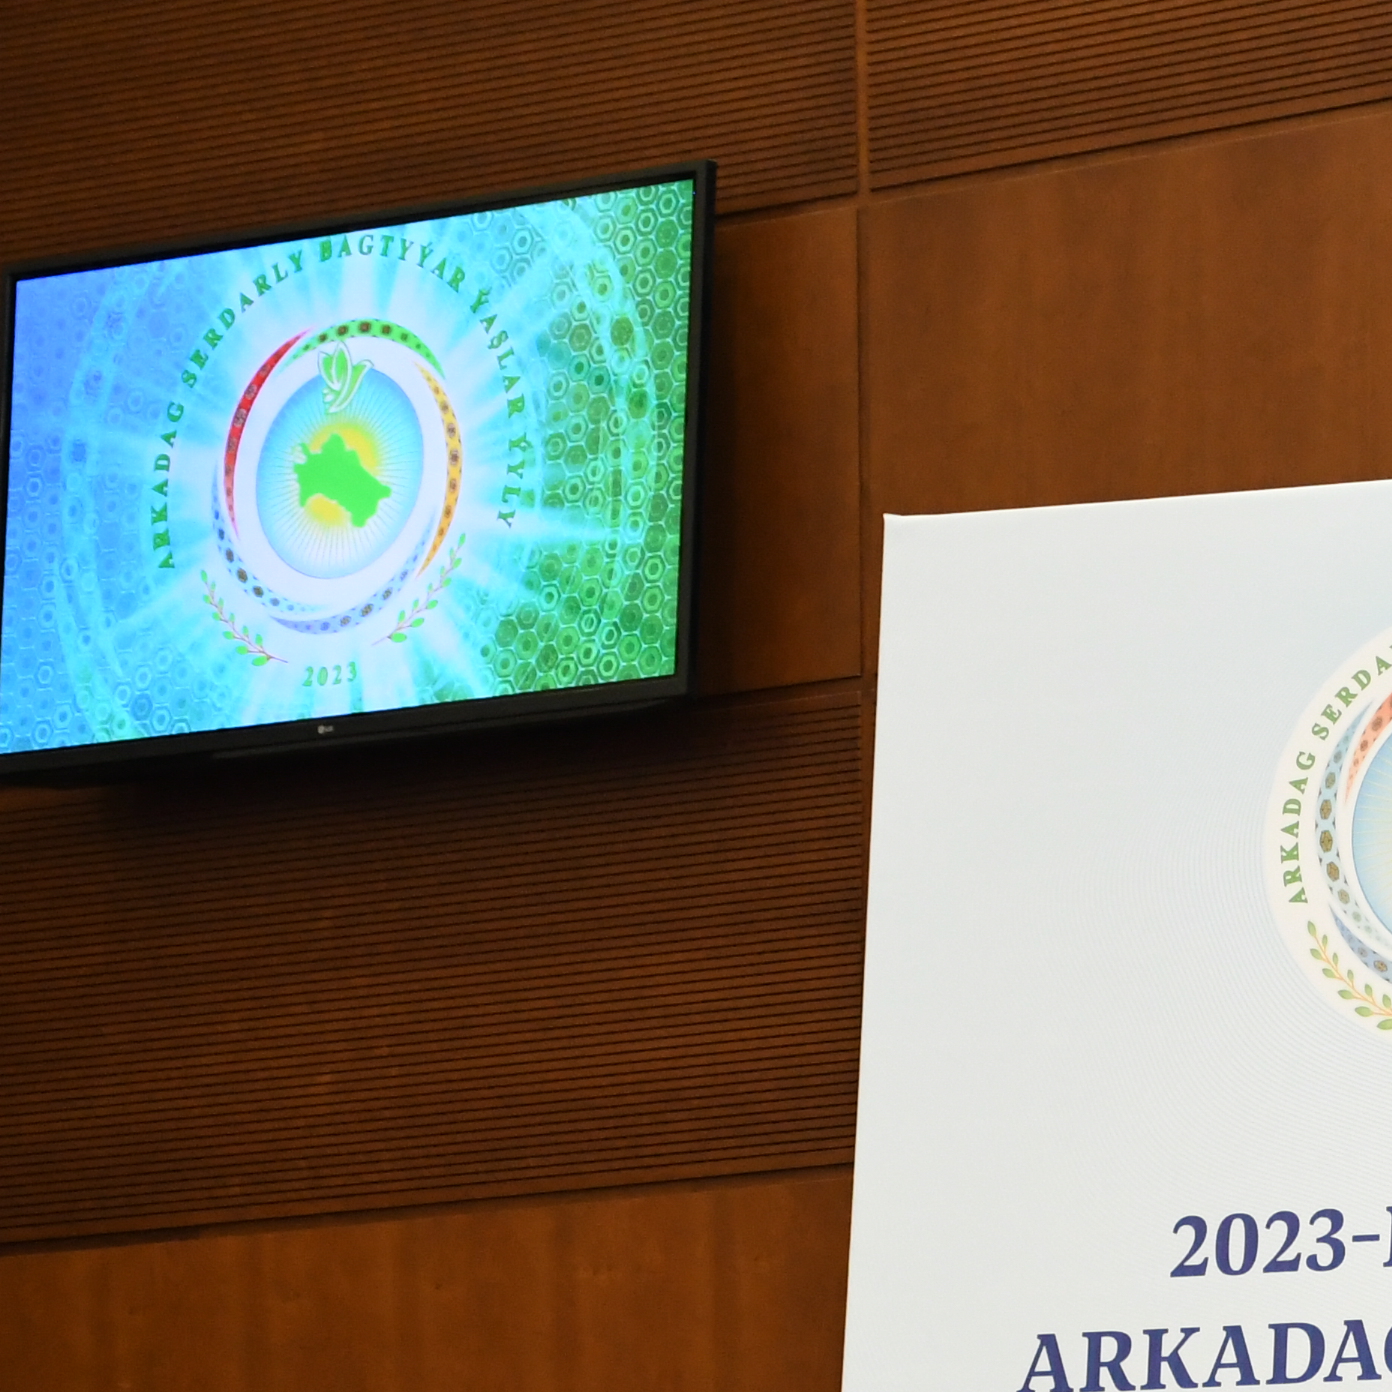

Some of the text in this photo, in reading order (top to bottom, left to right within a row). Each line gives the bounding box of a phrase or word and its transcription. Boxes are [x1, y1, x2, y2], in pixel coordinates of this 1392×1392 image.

[151, 401, 185, 569] ARKADAG
[180, 249, 304, 389] SERDARLY
[318, 234, 467, 294] BAGTYÝAR
[302, 661, 358, 687] 2023
[1280, 751, 1317, 905] ARKADAG
